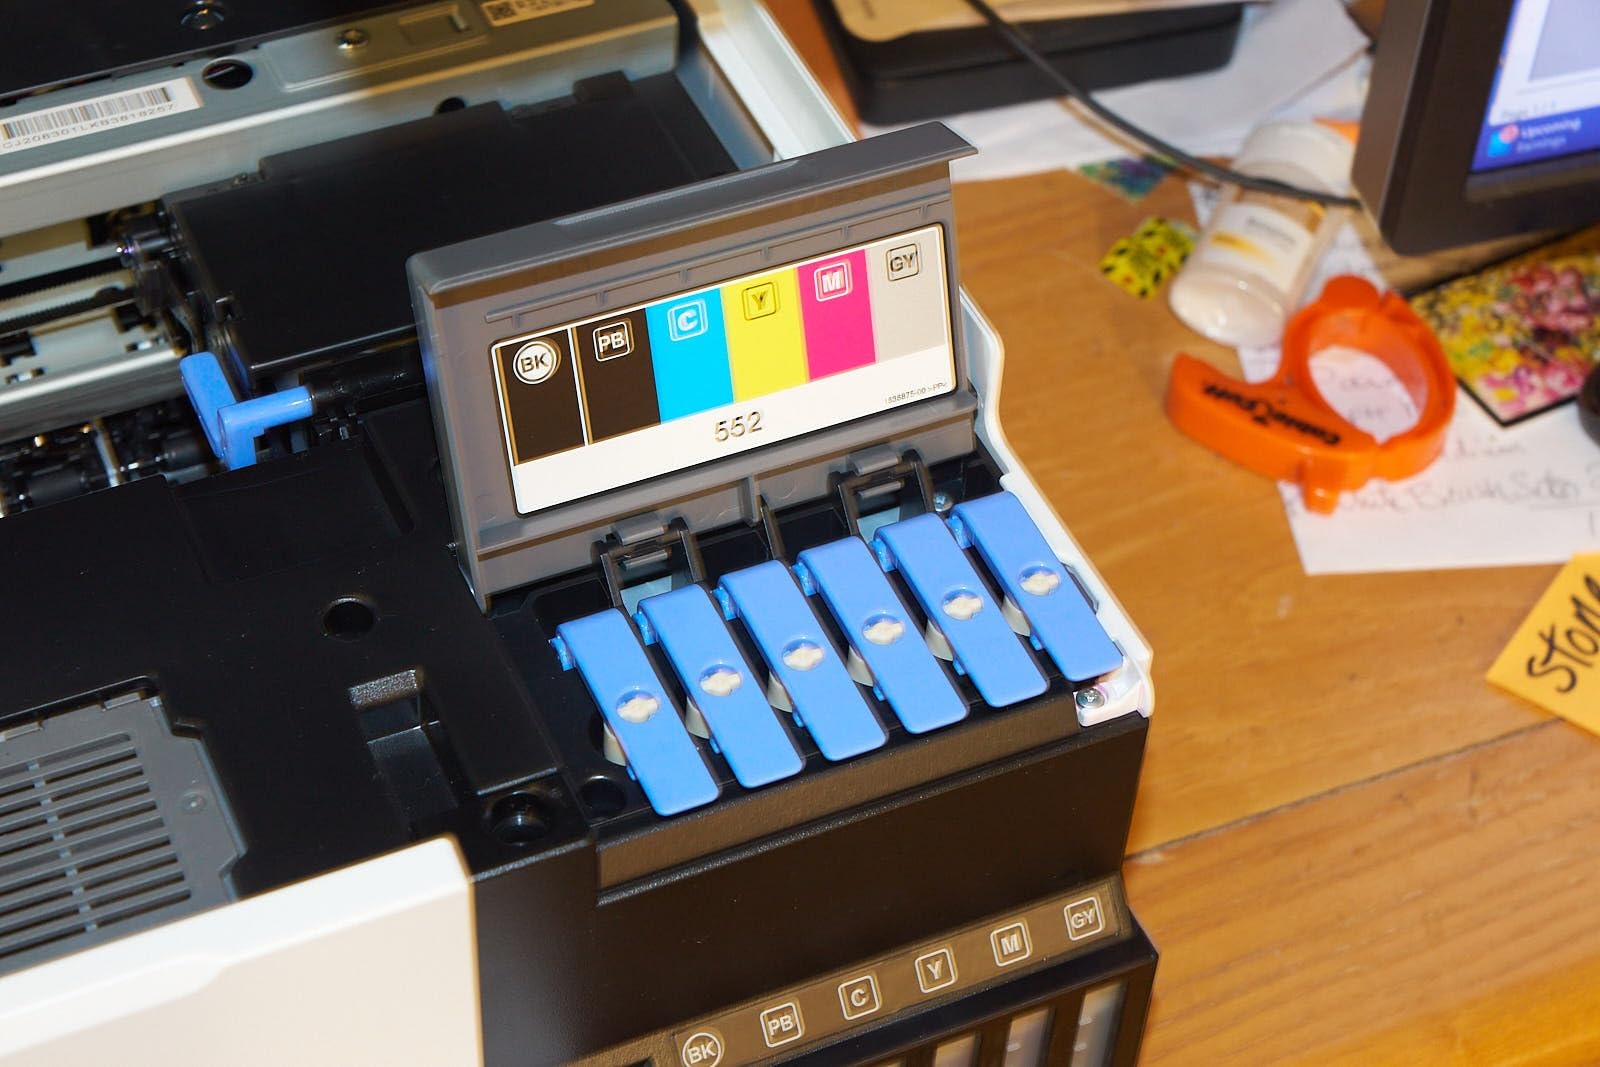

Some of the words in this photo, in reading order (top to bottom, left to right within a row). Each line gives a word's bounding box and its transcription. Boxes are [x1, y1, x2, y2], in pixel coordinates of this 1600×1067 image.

[889, 252, 917, 274] GY
[820, 270, 844, 293] M
[750, 290, 769, 311] Y
[676, 309, 699, 332] C
[598, 330, 627, 353] PB
[520, 352, 550, 374] BK
[714, 410, 763, 442] 552
[1070, 908, 1096, 929] GY
[1000, 933, 1020, 956] M
[926, 959, 943, 980] Y
[850, 988, 868, 1008] C
[767, 1014, 794, 1036] PB
[687, 1040, 717, 1065] BK
